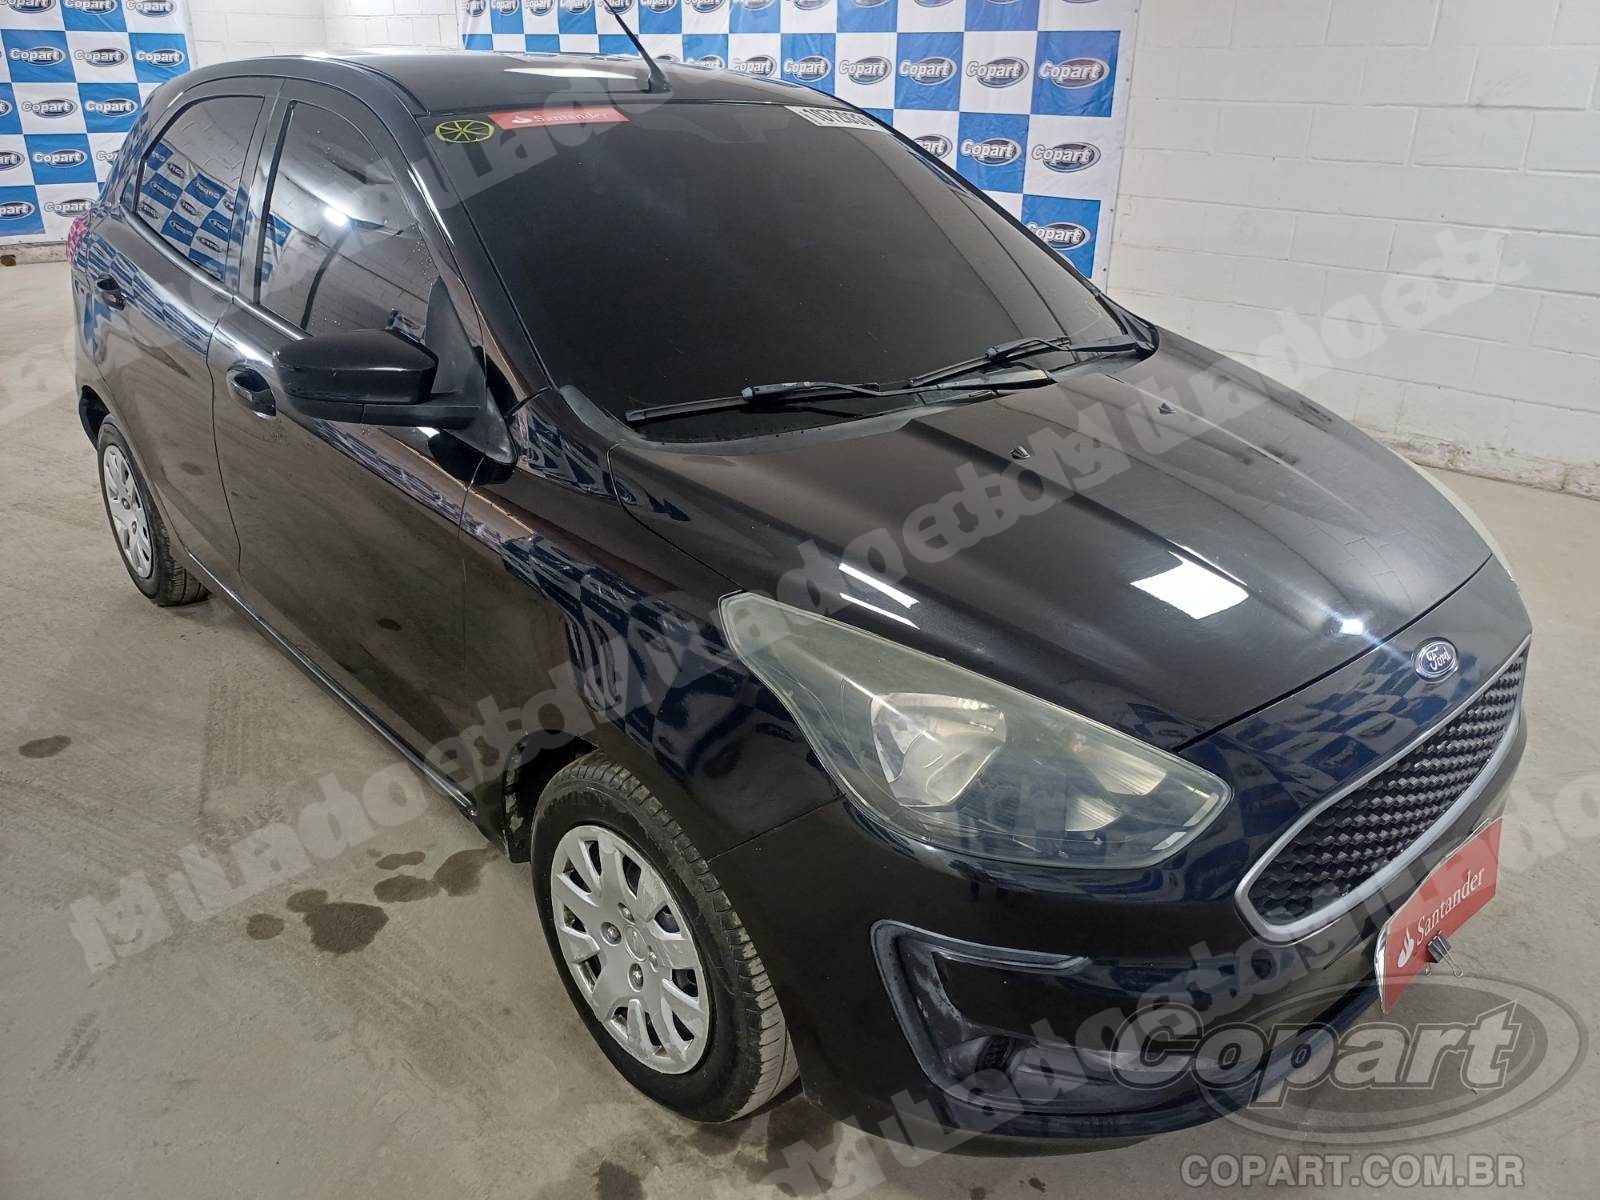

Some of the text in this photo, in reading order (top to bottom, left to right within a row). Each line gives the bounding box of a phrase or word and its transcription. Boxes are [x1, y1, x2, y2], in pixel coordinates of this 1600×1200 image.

[63, 0, 111, 10] Copart
[126, 0, 172, 12] Copart
[10, 48, 59, 62] Copart
[74, 49, 124, 64] Copart
[135, 51, 180, 65] Copart
[784, 58, 826, 75] Copart
[839, 59, 884, 76] Copart
[900, 60, 950, 77] Copart
[965, 61, 1020, 80] Copart
[1039, 60, 1102, 82] Copart
[22, 100, 72, 115] Copart
[86, 100, 132, 114] Copart
[533, 111, 608, 123] Santander
[961, 140, 1014, 159] Copart
[1031, 144, 1091, 165] Copart
[33, 152, 81, 166] Copart
[1425, 645, 1452, 672] Ford
[1416, 867, 1485, 946] Santander
